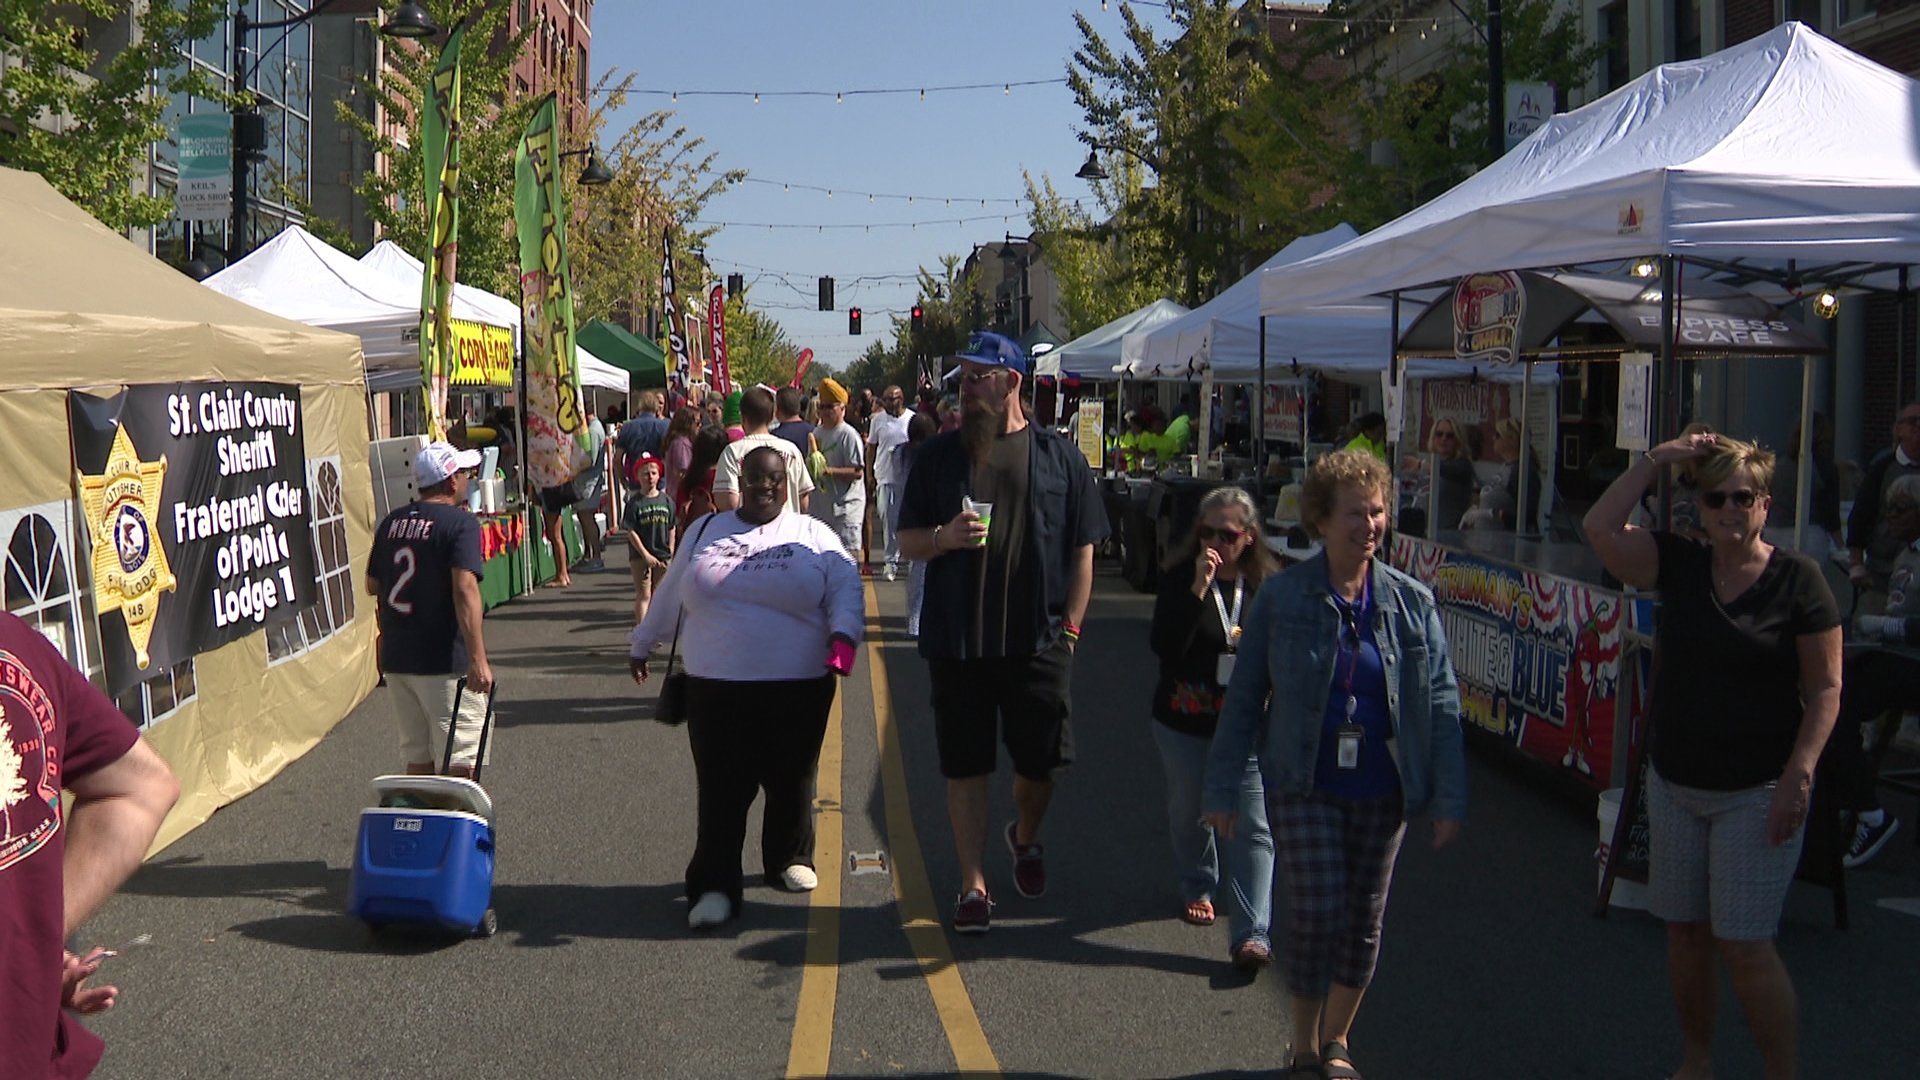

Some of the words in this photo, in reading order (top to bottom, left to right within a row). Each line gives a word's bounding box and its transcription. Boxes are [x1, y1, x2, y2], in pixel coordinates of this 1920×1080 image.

[180, 136, 228, 144] BELONGING
[180, 149, 228, 157] BELLEVILLE
[180, 194, 206, 202] CLOCK
[207, 193, 229, 201] SHOP
[191, 182, 217, 190] KEIL'S
[1638, 316, 1789, 332] EPRESS
[1682, 329, 1773, 344] CAFE
[460, 327, 490, 379] CORN
[494, 340, 510, 371] COB
[167, 393, 198, 436] St.
[200, 389, 242, 433] Clair
[243, 390, 296, 436] County
[173, 485, 265, 544] Fraternal
[265, 480, 302, 520] Oder
[387, 518, 434, 540] MOORE
[216, 536, 239, 579] of
[387, 546, 416, 614] 2
[128, 603, 145, 618] 148
[212, 576, 278, 628] Lodge
[1438, 562, 1534, 631] TRUMAN'S
[1496, 631, 1513, 691] &
[1510, 631, 1571, 730] BLUE
